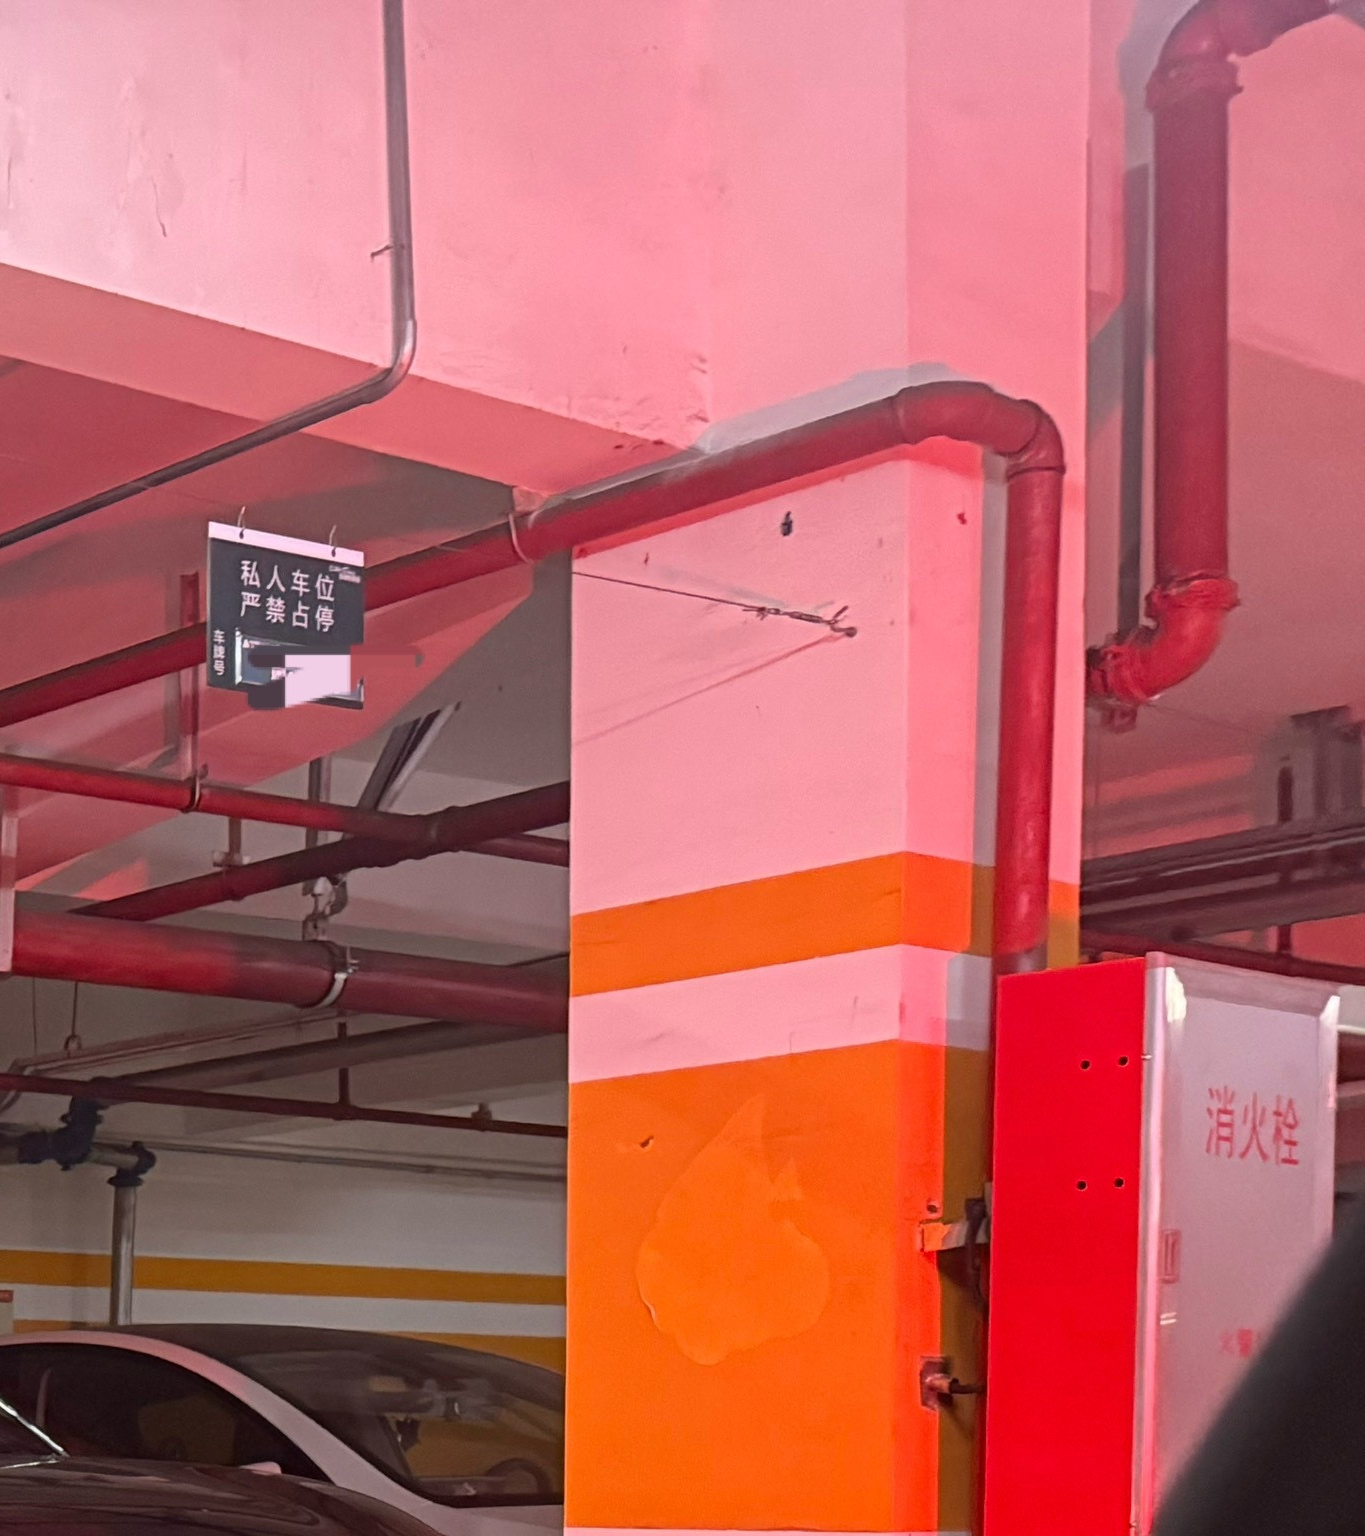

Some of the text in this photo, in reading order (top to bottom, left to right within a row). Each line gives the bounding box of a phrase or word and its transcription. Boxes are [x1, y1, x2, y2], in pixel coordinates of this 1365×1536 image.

[240, 559, 336, 603] 私人车位
[239, 591, 335, 633] 严禁占停
[1205, 1085, 1300, 1166] 消火栓
